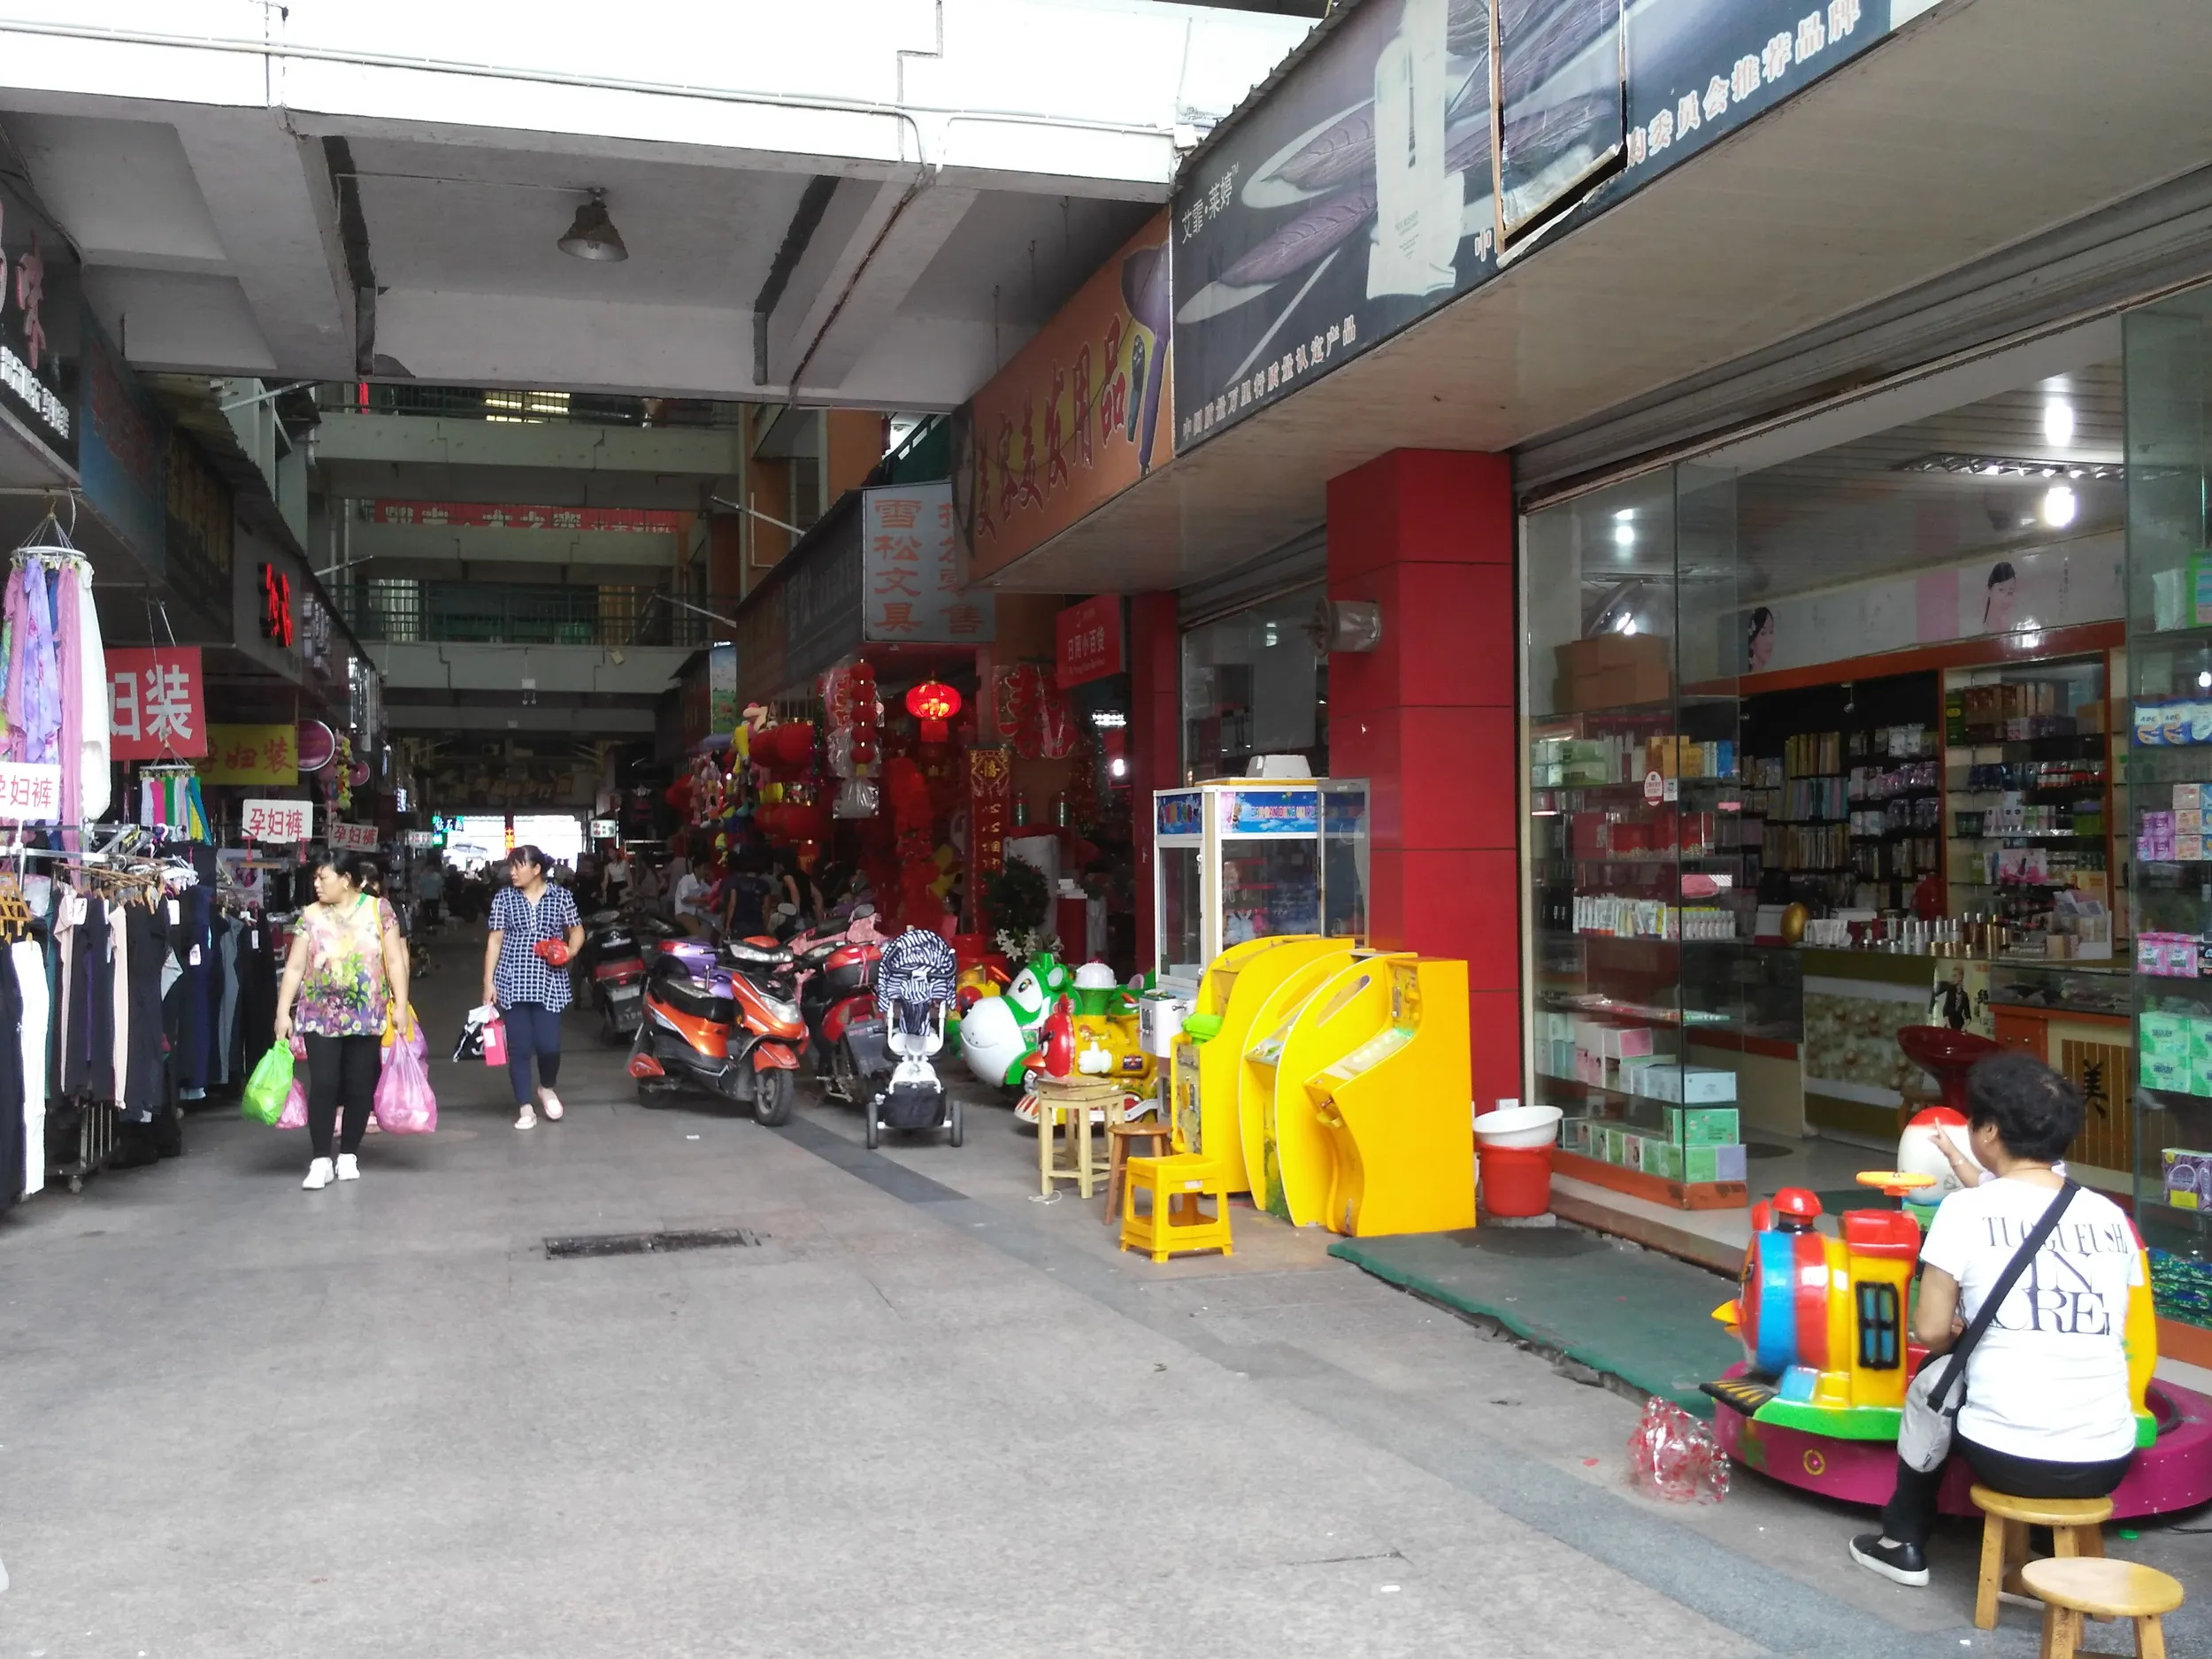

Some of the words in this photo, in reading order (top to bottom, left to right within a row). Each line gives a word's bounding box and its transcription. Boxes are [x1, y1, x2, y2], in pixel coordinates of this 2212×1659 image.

[1183, 314, 1356, 442] 中国质量万里行质量认定产品
[873, 499, 925, 634] 雪松文具
[250, 808, 303, 837] 孕妇裤
[334, 825, 376, 847] 孕妇裤
